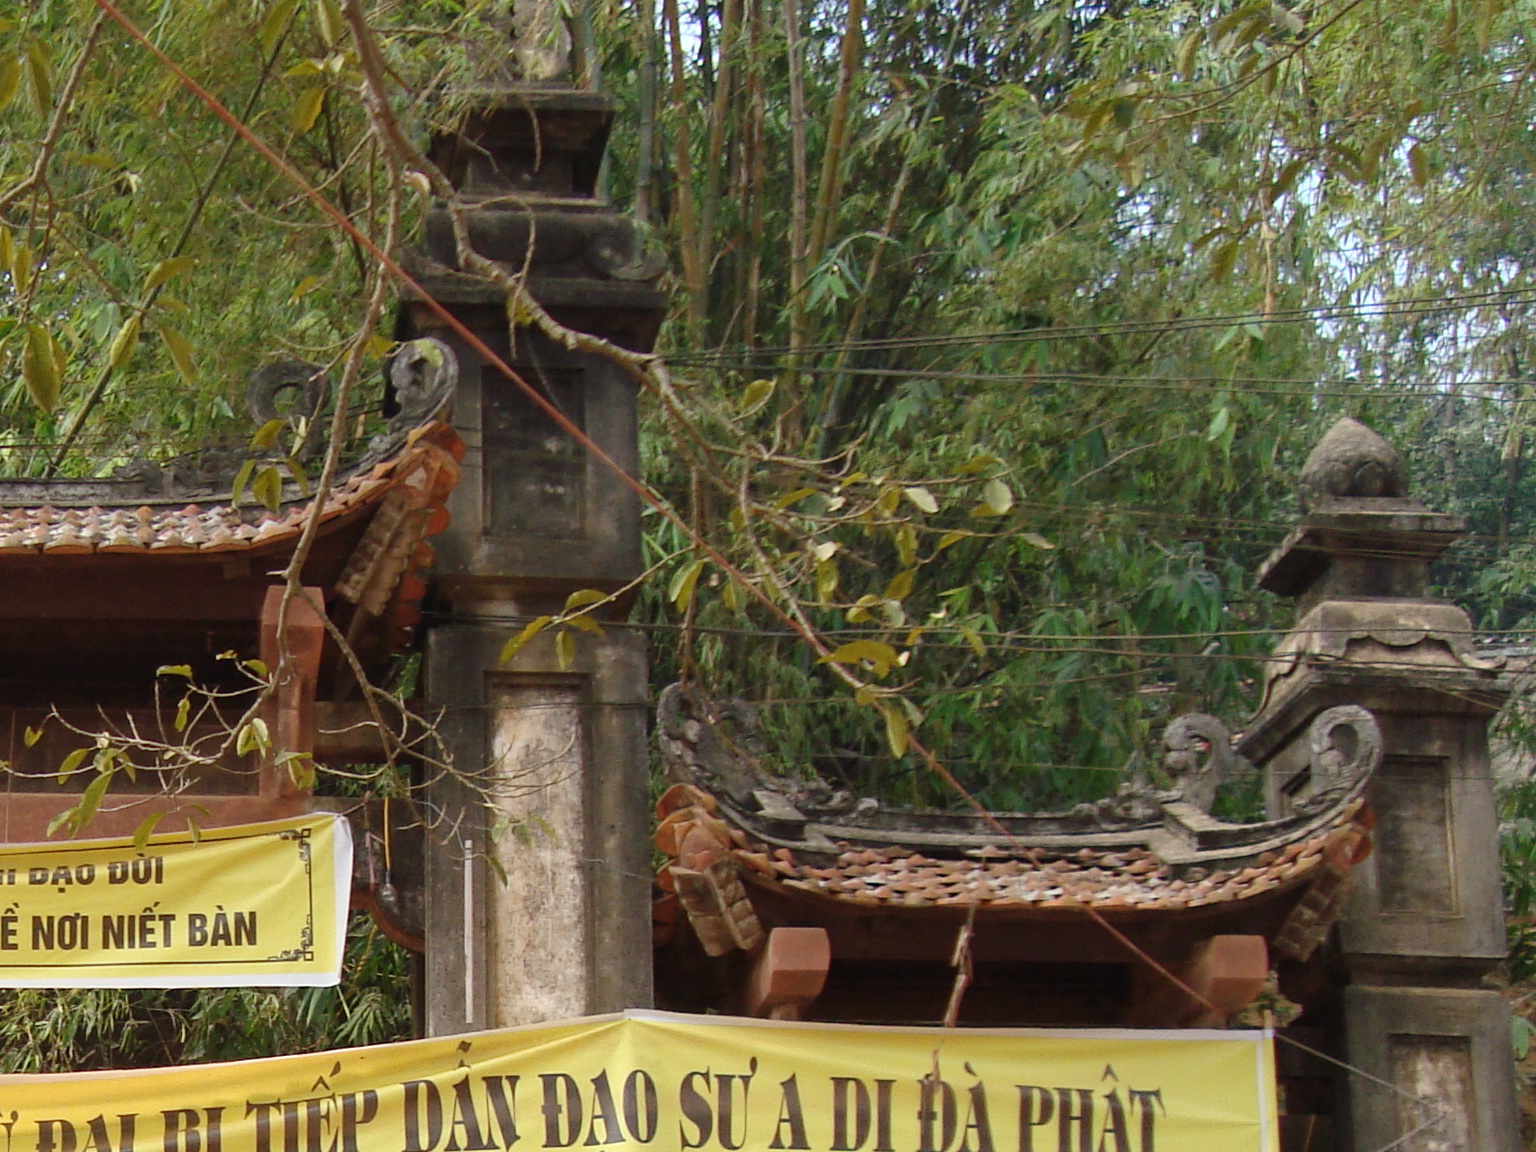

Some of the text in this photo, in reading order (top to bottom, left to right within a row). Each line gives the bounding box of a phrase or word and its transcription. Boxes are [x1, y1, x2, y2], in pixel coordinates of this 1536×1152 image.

[31, 911, 90, 951] NƠI
[102, 901, 177, 951] NIẾT
[187, 903, 258, 948] BÀN
[678, 1055, 759, 1152] SƯ
[769, 1072, 812, 1151] A
